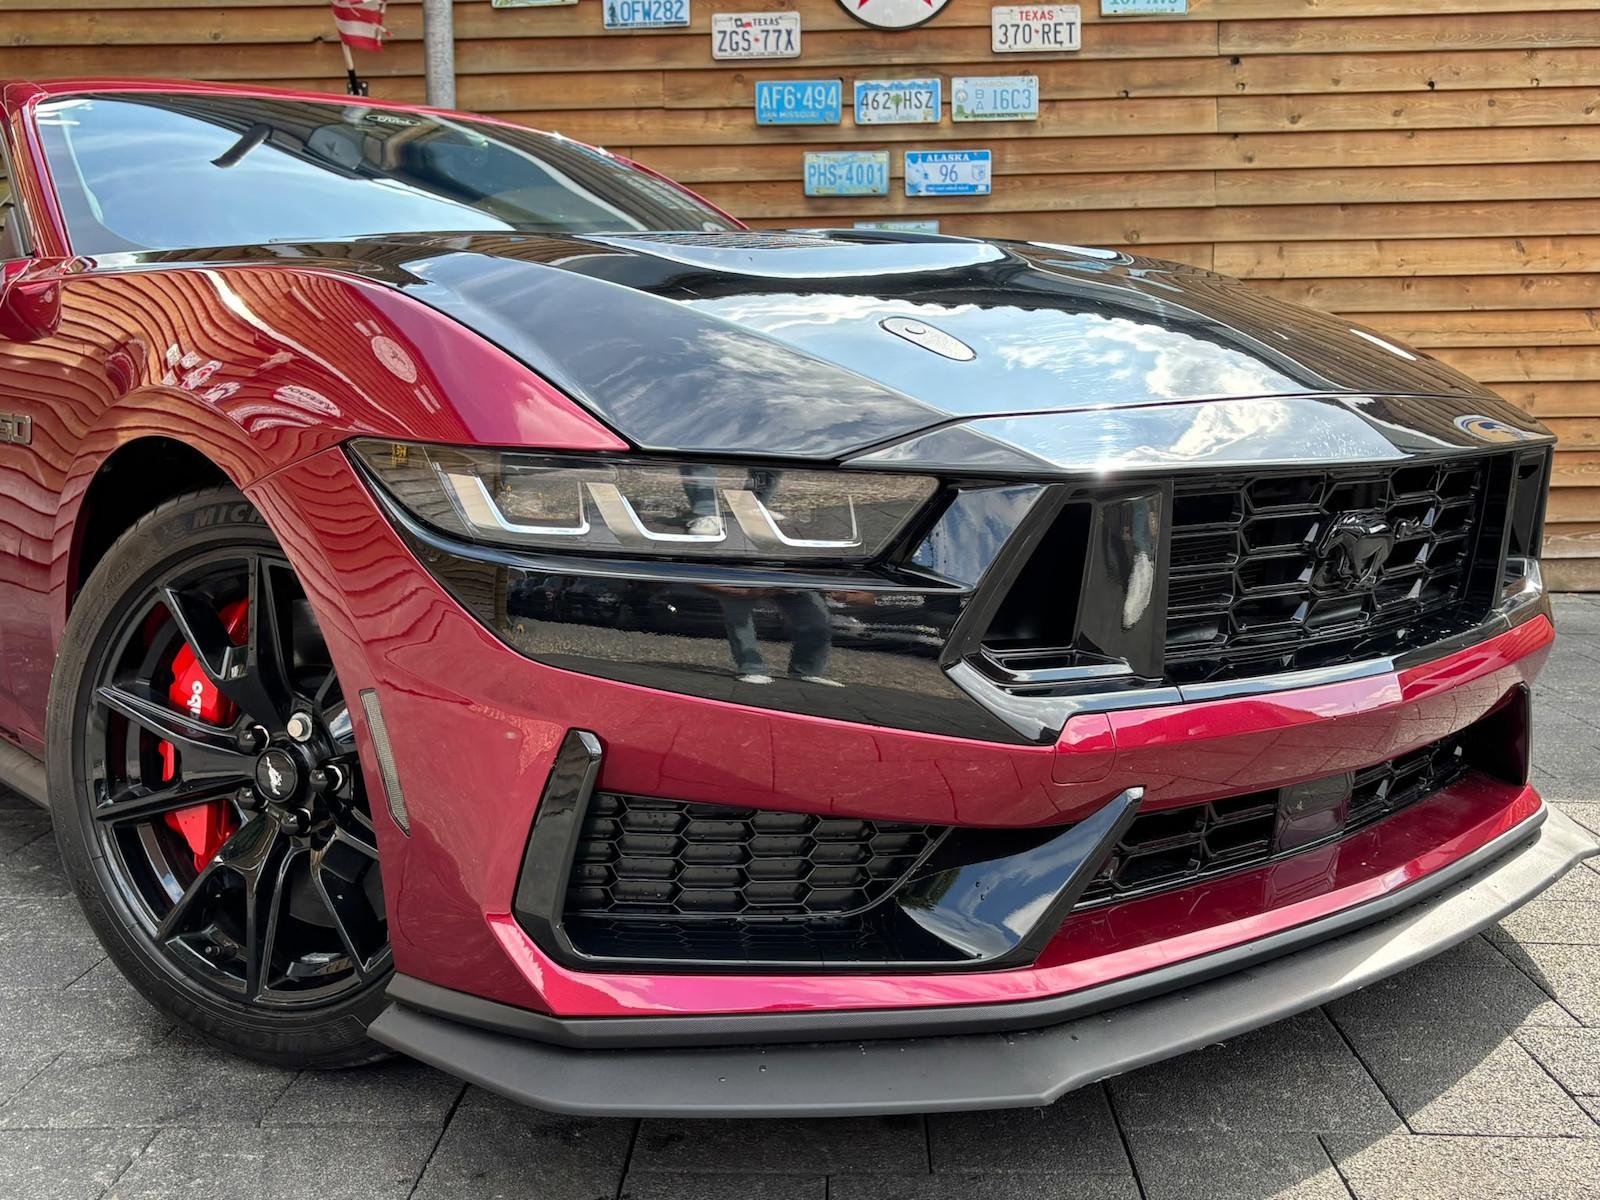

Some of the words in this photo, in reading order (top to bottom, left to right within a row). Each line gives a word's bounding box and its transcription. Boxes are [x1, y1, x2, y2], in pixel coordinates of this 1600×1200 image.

[752, 17, 780, 26] TEXAS
[1019, 10, 1054, 21] TEXAS
[860, 91, 891, 110] 462
[903, 90, 934, 109] HSZ
[992, 88, 1032, 110] 16C3
[926, 153, 970, 161] ALASKA
[939, 163, 959, 183] 96
